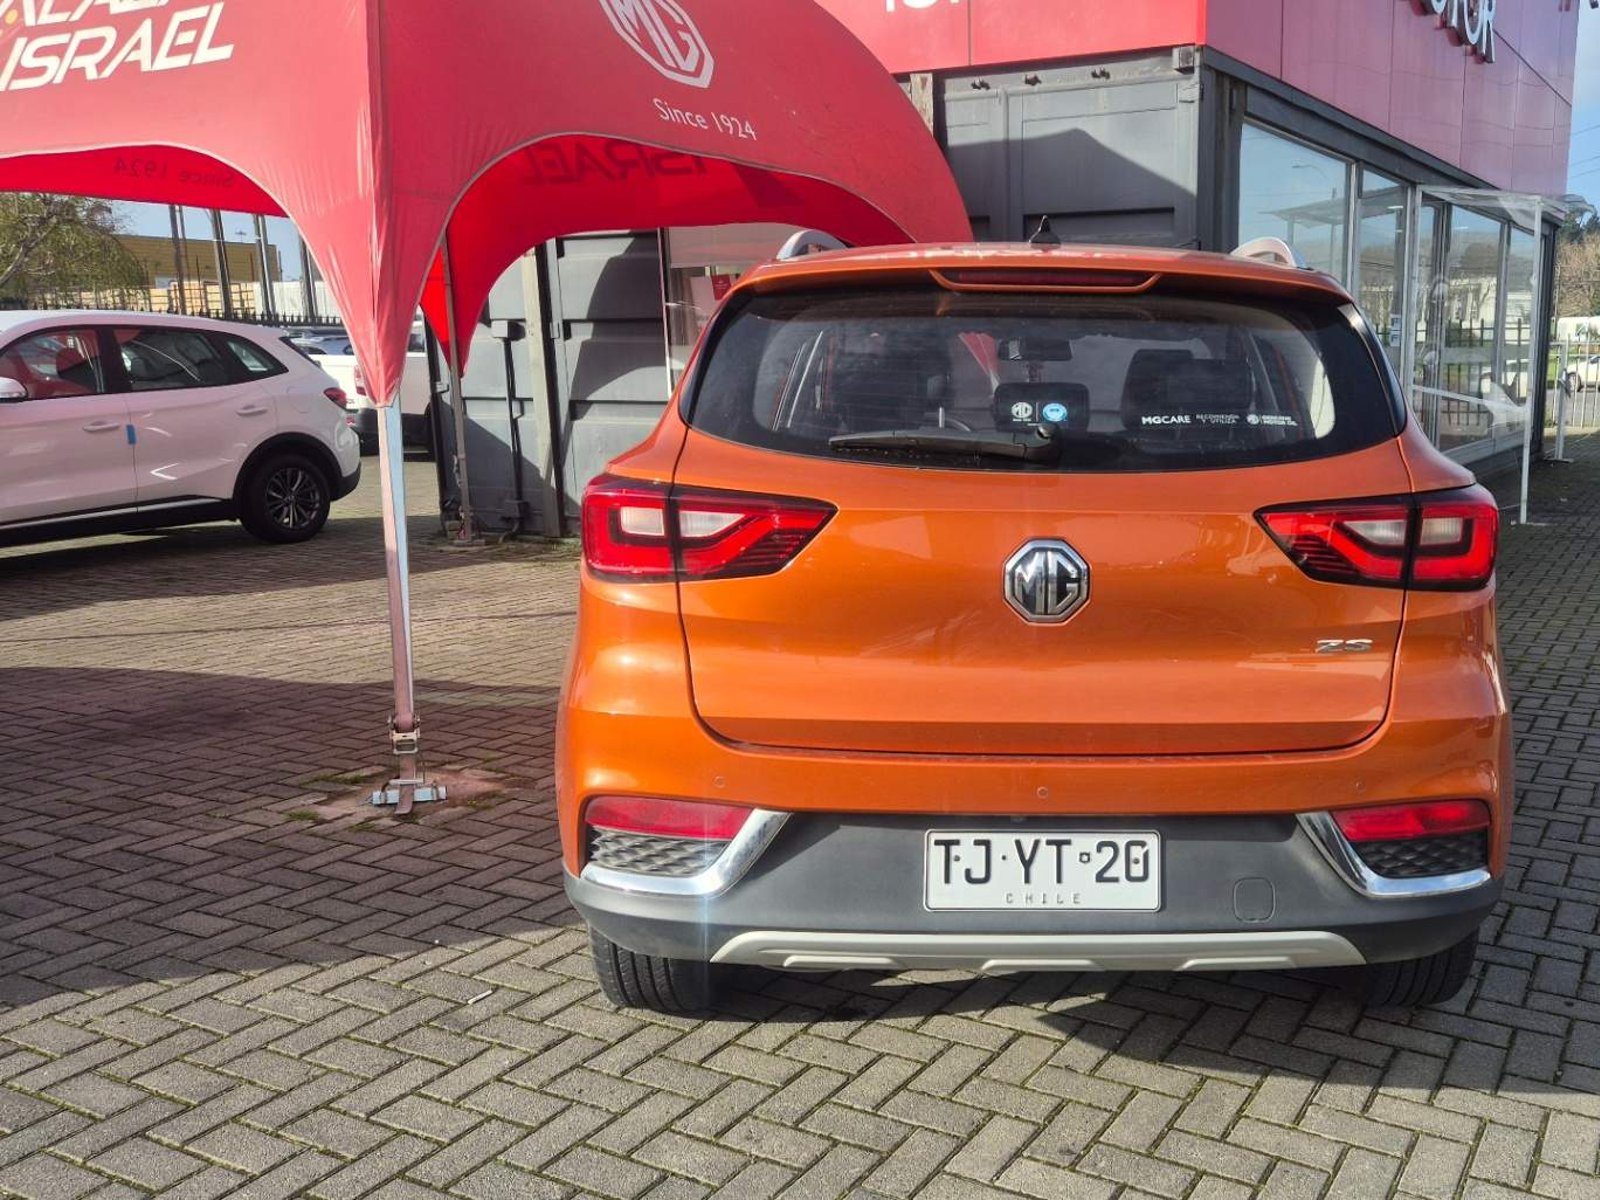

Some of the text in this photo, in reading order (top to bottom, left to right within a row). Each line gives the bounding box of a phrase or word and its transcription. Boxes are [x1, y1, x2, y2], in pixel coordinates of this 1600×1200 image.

[0, 2, 234, 91] ISRAEL
[653, 98, 757, 141] Since 1924
[1011, 547, 1083, 619] MG
[1315, 639, 1373, 653] ZS
[1006, 892, 1081, 904] CHILE
